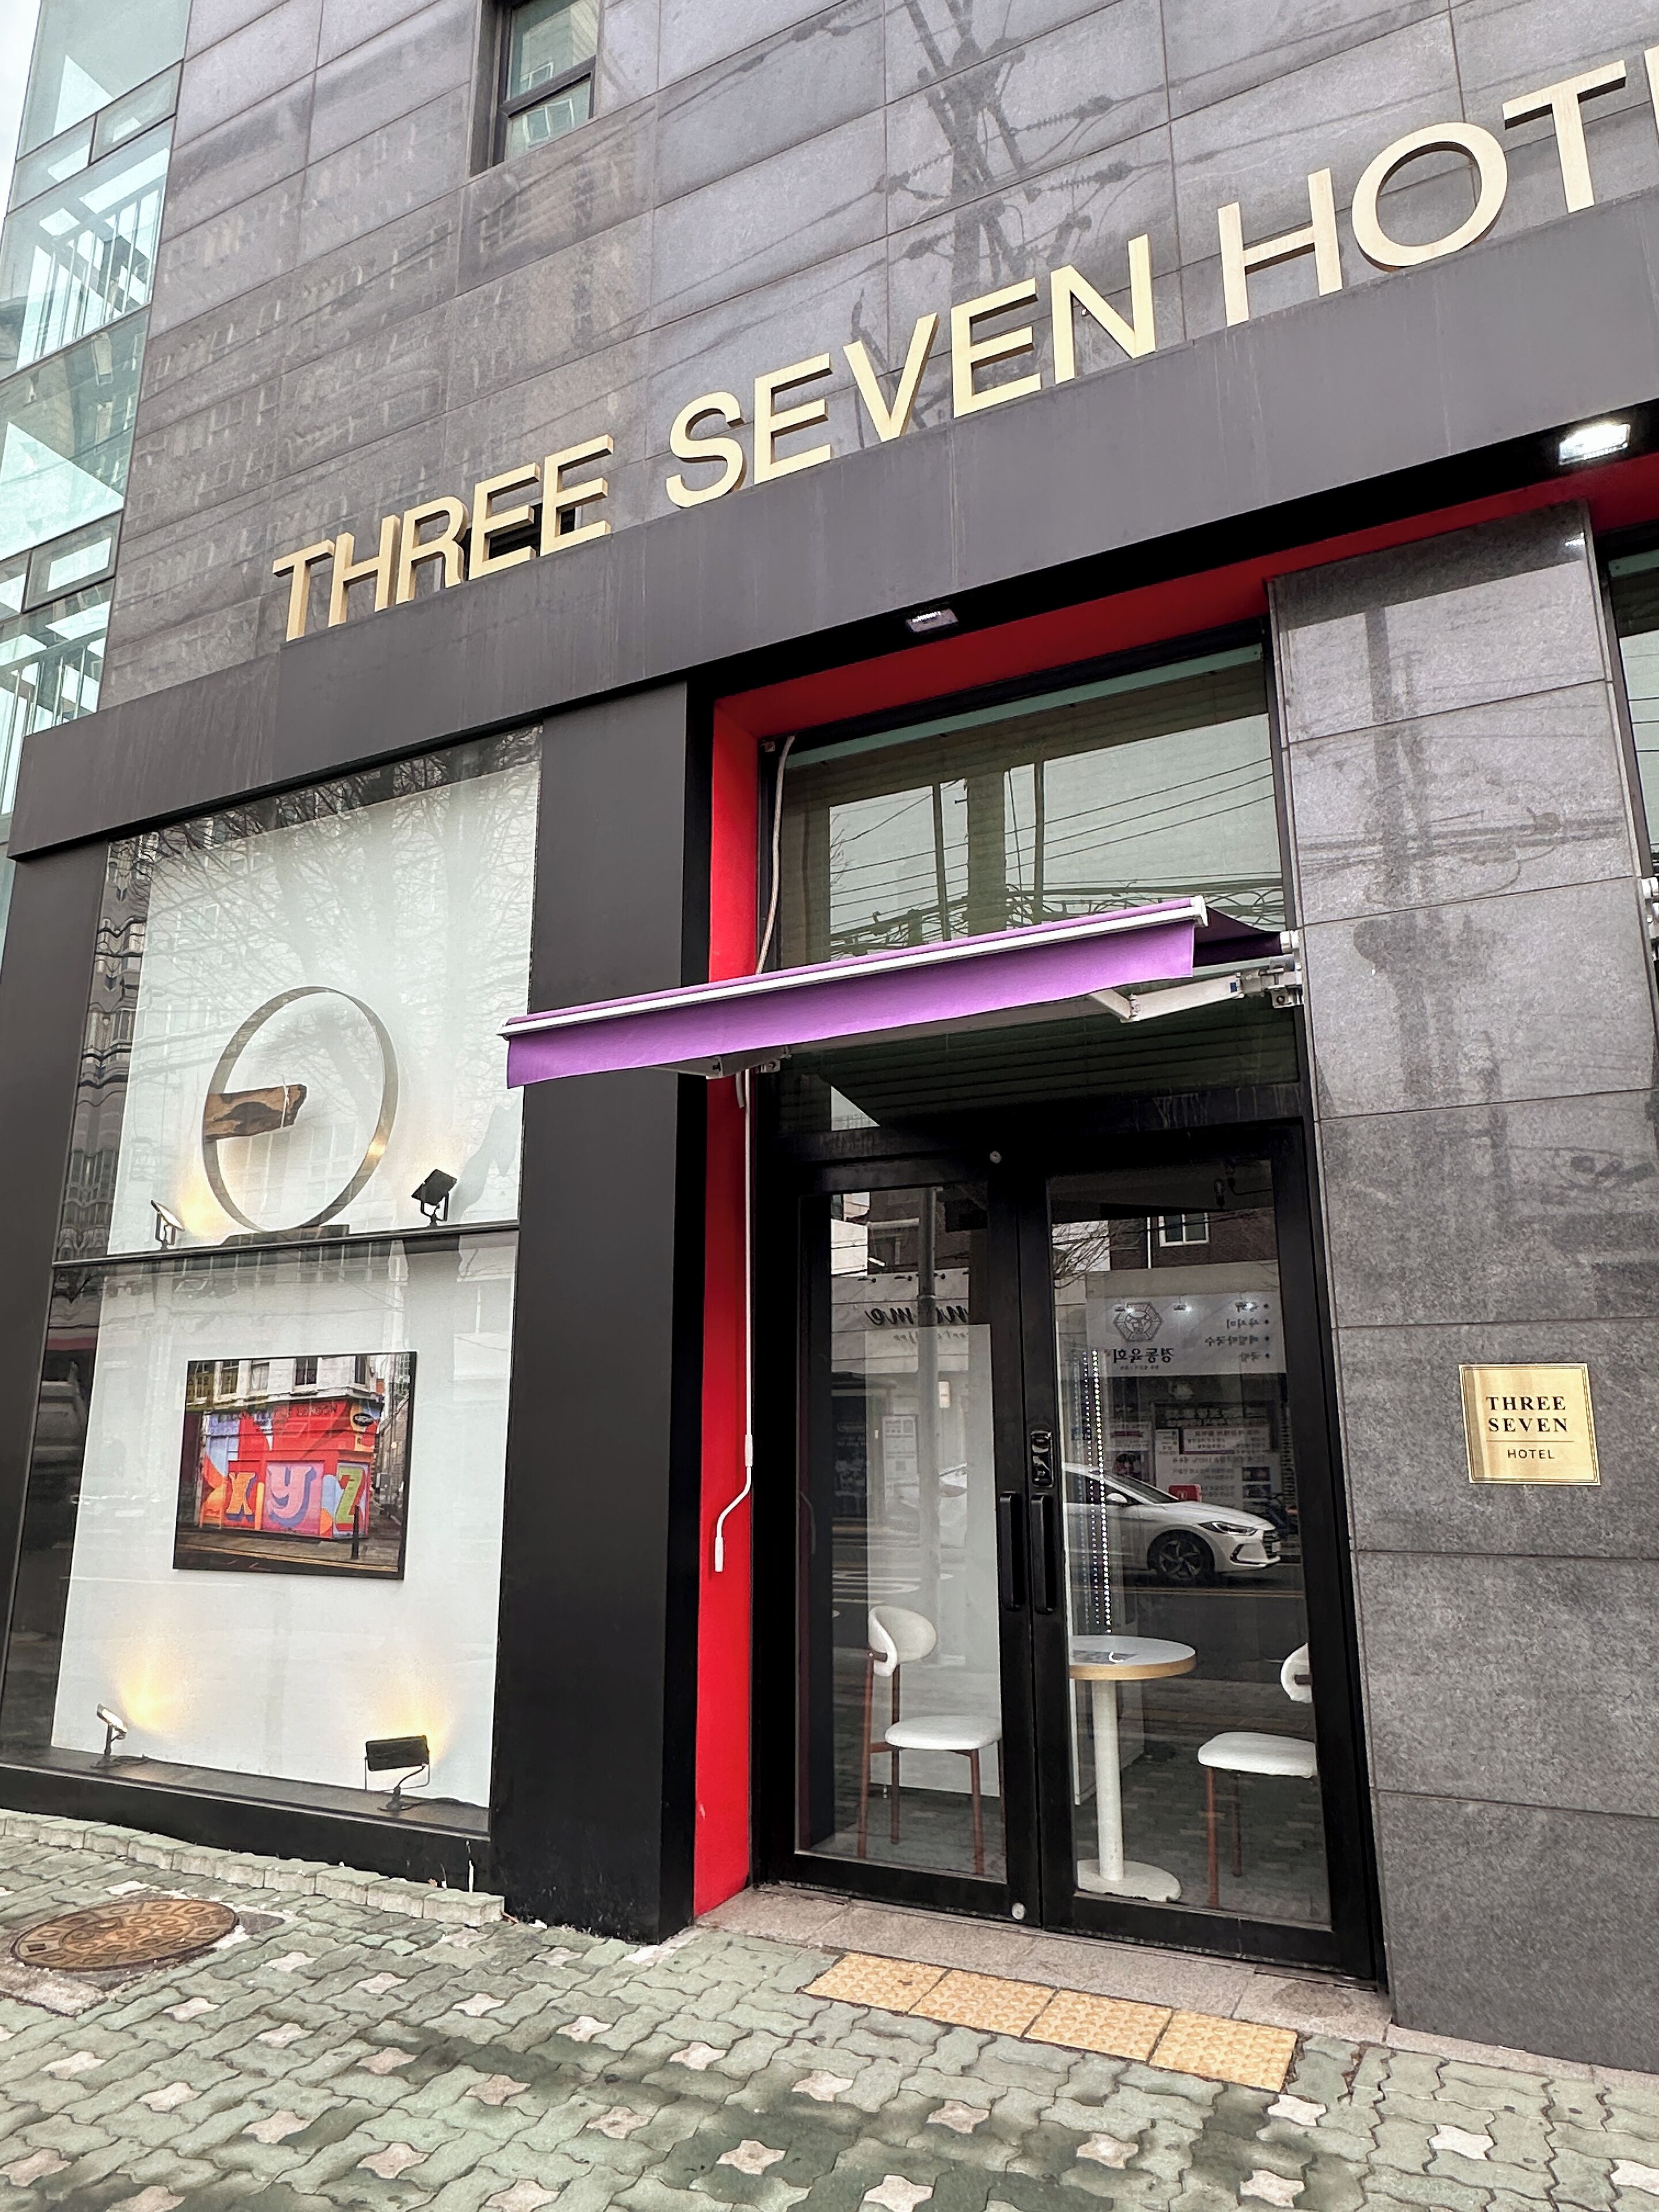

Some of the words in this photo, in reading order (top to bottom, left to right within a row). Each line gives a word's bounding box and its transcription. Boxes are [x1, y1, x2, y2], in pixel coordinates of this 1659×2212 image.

[272, 434, 614, 642] THREE
[665, 234, 1157, 509] SEVEN
[1217, 45, 1659, 328] HOT
[1486, 1396, 1567, 1411] THREE
[1488, 1418, 1568, 1432] SEVEN
[1507, 1449, 1555, 1459] HOTEL
